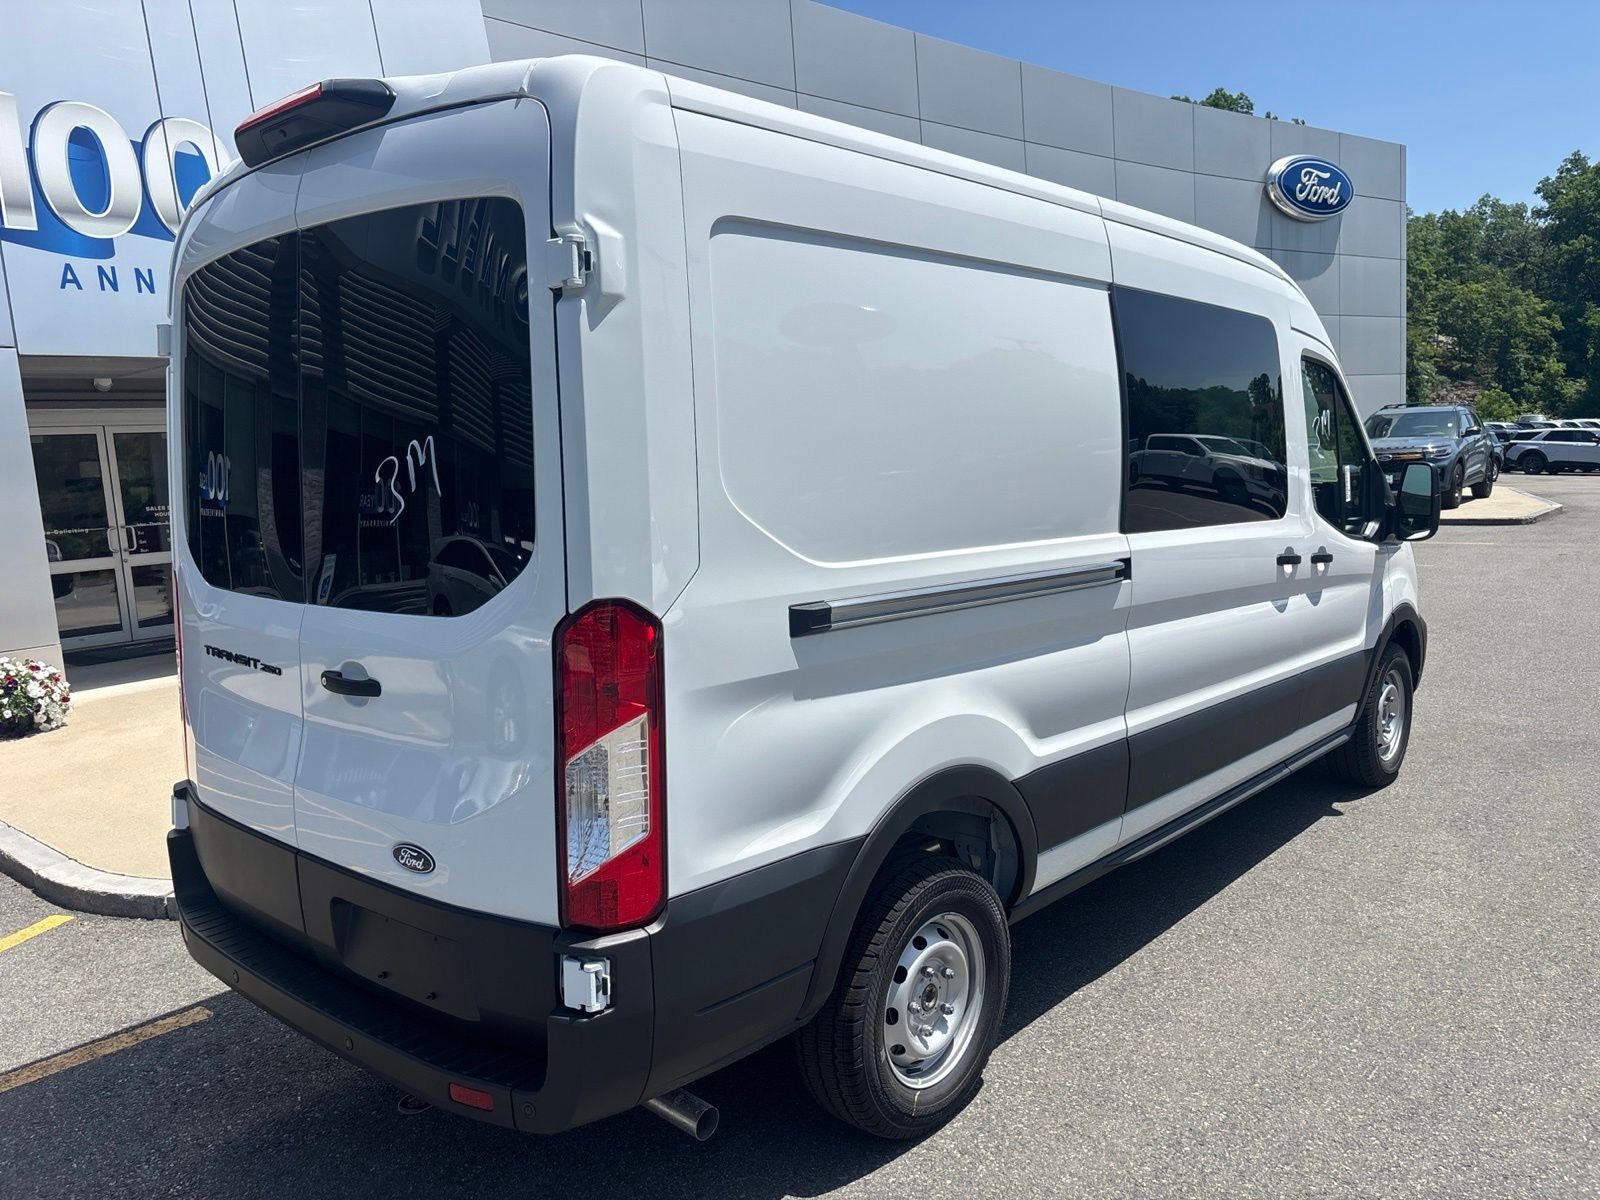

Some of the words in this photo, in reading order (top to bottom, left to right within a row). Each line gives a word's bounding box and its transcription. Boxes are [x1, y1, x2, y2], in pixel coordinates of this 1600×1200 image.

[1296, 167, 1340, 206] Ford
[60, 263, 156, 294] ANN
[204, 644, 260, 669] TRANSIT
[260, 663, 282, 676] 250
[399, 848, 424, 870] Ford
